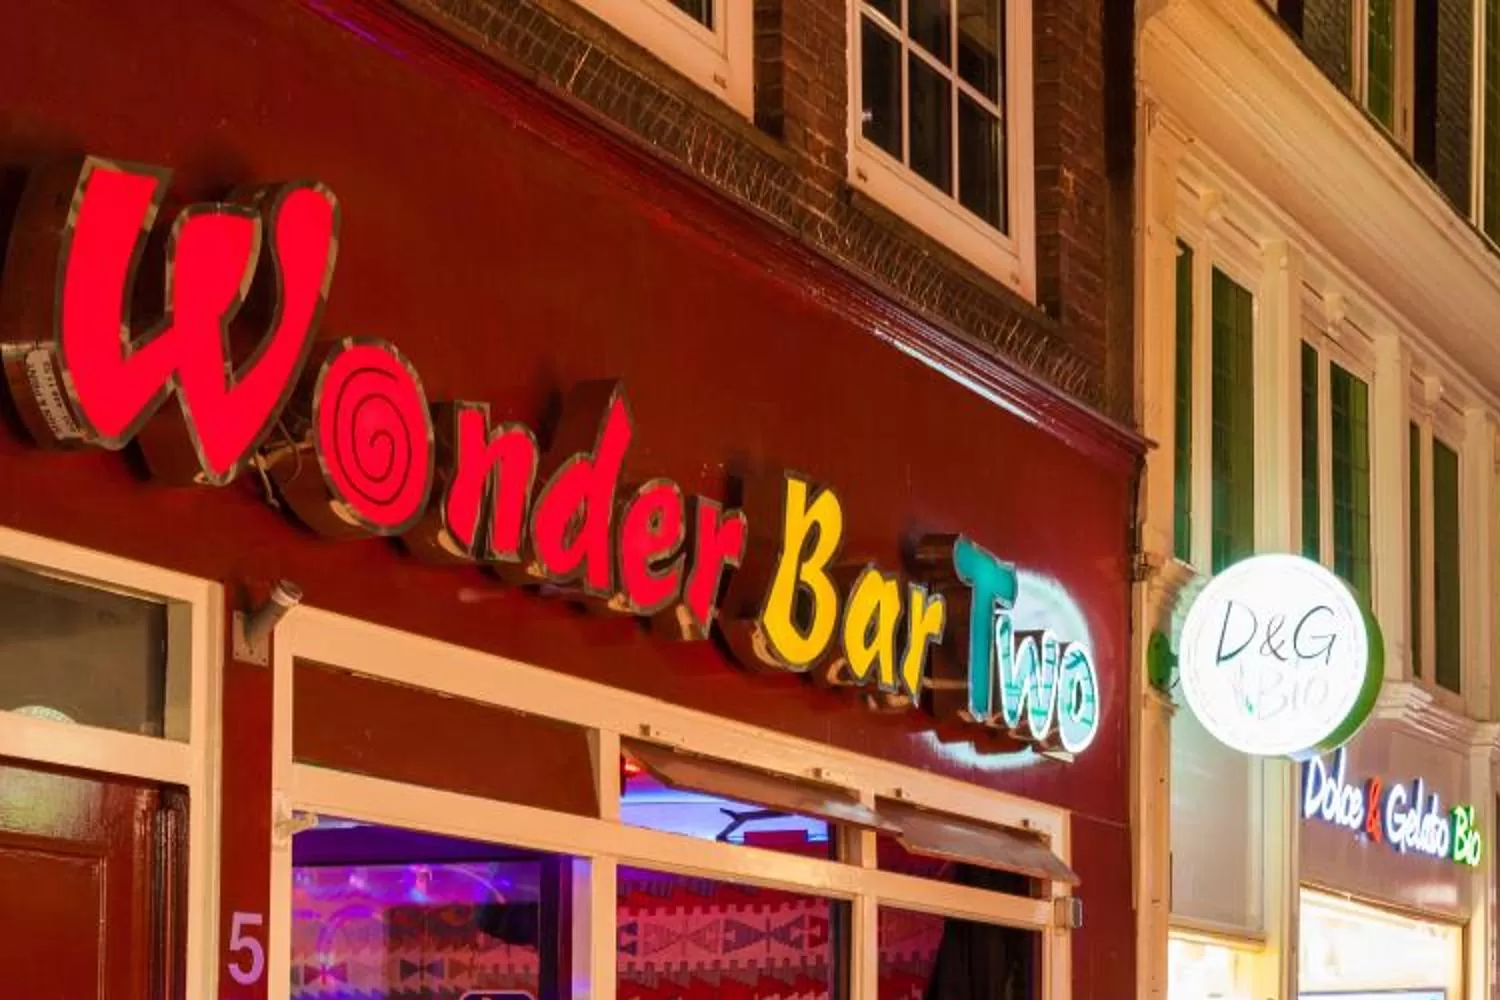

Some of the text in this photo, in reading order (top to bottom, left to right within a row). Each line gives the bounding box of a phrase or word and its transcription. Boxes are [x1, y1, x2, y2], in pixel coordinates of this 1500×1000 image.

[60, 158, 1099, 753] Wonder Bar Two
[1215, 600, 1337, 666] D&G
[1303, 748, 1482, 866] Dolce & Gelato Bio
[228, 911, 265, 985] 5
